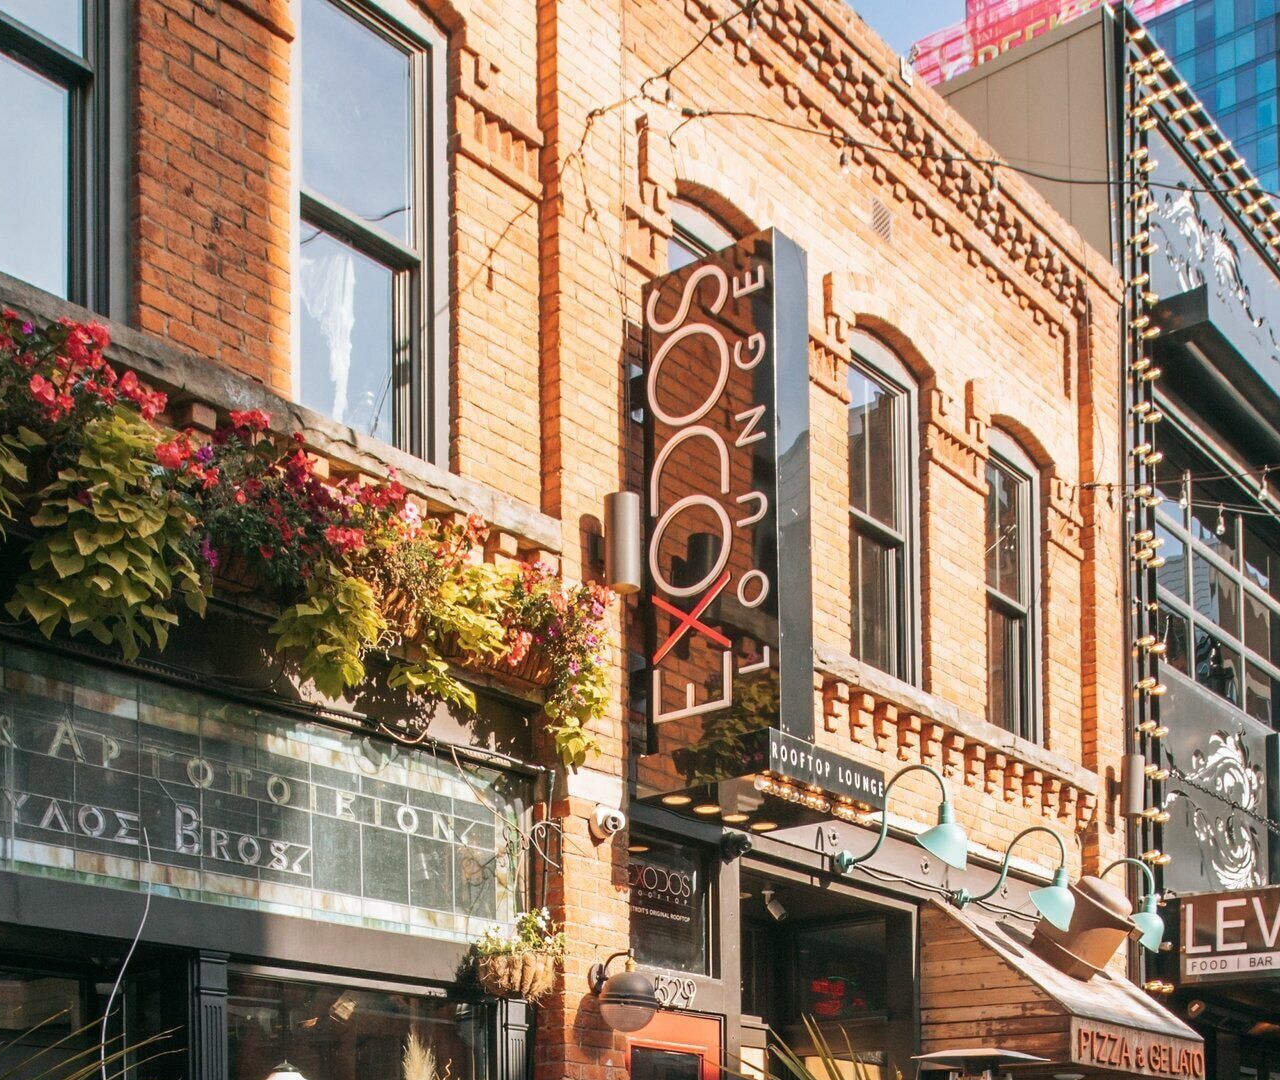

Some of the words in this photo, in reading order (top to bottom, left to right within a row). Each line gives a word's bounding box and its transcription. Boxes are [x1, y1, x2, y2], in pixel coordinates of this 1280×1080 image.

[732, 264, 772, 676] LOUNGE
[646, 263, 733, 725] EXODOS
[771, 741, 831, 778] ROOFTOP
[838, 766, 884, 798] LOUNGE
[631, 905, 649, 915] TROIT'S
[650, 909, 670, 919] ORIGINAL
[670, 913, 691, 923] ROOFTOP
[637, 889, 688, 906] OOFTOP
[1191, 959, 1228, 971] FOOD
[1249, 956, 1273, 967] BAR
[654, 975, 697, 1008] 529
[1078, 1028, 1131, 1067] PIZZA
[1148, 1041, 1204, 1078] GELATO
